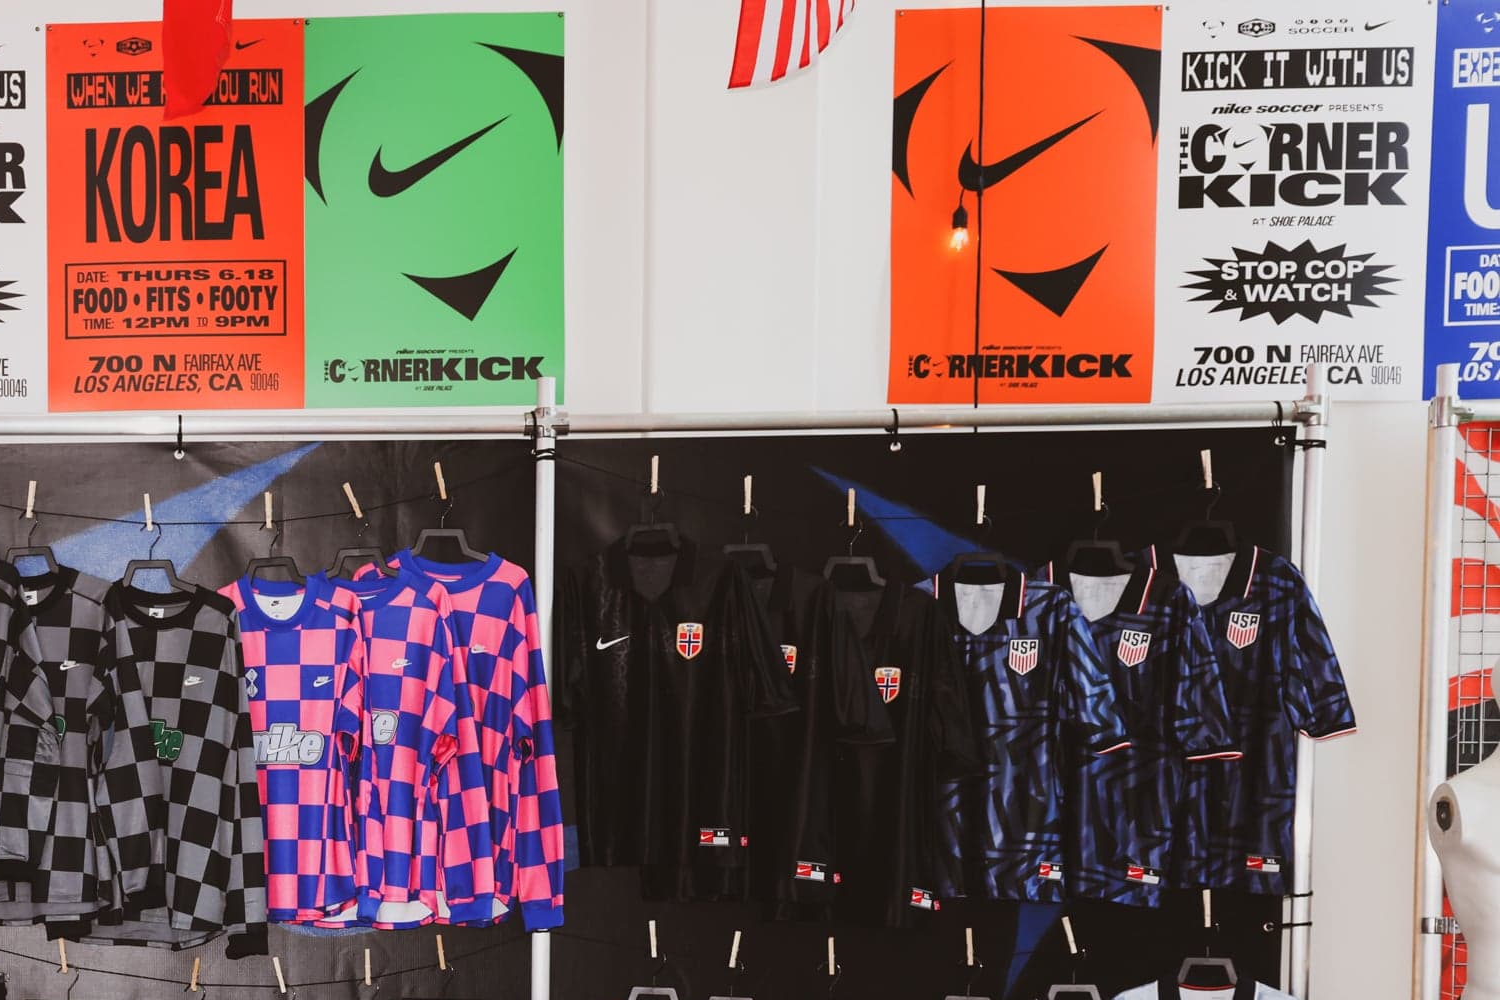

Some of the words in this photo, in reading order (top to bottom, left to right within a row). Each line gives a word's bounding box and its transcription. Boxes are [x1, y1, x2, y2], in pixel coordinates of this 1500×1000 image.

[1288, 26, 1354, 35] SOCCER
[1185, 53, 1246, 89] KICK
[1263, 52, 1290, 87] IT
[1306, 50, 1367, 86] WITH
[1382, 49, 1410, 85] US
[70, 74, 116, 106] WHEN
[126, 74, 150, 105] WE
[249, 72, 280, 103] RUN
[1212, 103, 1252, 115] nike
[1256, 104, 1324, 114] soccer
[1328, 104, 1384, 112] PRESENTS
[1180, 126, 1190, 174] THE
[85, 124, 264, 243] KOREA
[1178, 172, 1408, 210] KICK
[1269, 216, 1296, 227] SHOE
[1298, 216, 1336, 226] PALACE
[1221, 261, 1298, 282] STOP,
[1304, 260, 1364, 280] COP
[1480, 254, 1500, 268] DA
[76, 271, 109, 284] DATE:
[117, 270, 210, 282] THURS
[1454, 270, 1500, 300] FOO
[73, 288, 128, 314] FOOD
[146, 286, 190, 312] FITS
[209, 285, 278, 312] FOOTY
[1224, 290, 1238, 300] &
[1243, 284, 1351, 302] WATCH
[84, 318, 114, 330] TIME:
[122, 316, 190, 328] 12PM
[196, 316, 208, 328] TO
[215, 316, 270, 328] 9PM
[88, 356, 143, 374] 700
[153, 354, 176, 372] N
[184, 354, 234, 372] FAIRFAX
[237, 353, 262, 371] AVE
[1194, 346, 1254, 365] 700
[1266, 345, 1291, 363] N
[1300, 345, 1355, 364] FAIRFAX
[1358, 344, 1384, 364] AVE
[1176, 367, 1217, 387] LOS
[1328, 366, 1364, 385] CA
[1371, 366, 1402, 384] 90046
[1458, 361, 1494, 382] OS
[74, 375, 110, 394] LOS
[112, 374, 202, 394] ANGELES,
[208, 373, 244, 392] CA
[250, 372, 279, 392] 90046
[1232, 613, 1260, 629] USA
[1011, 640, 1038, 655] USA
[1122, 630, 1150, 647] USA
